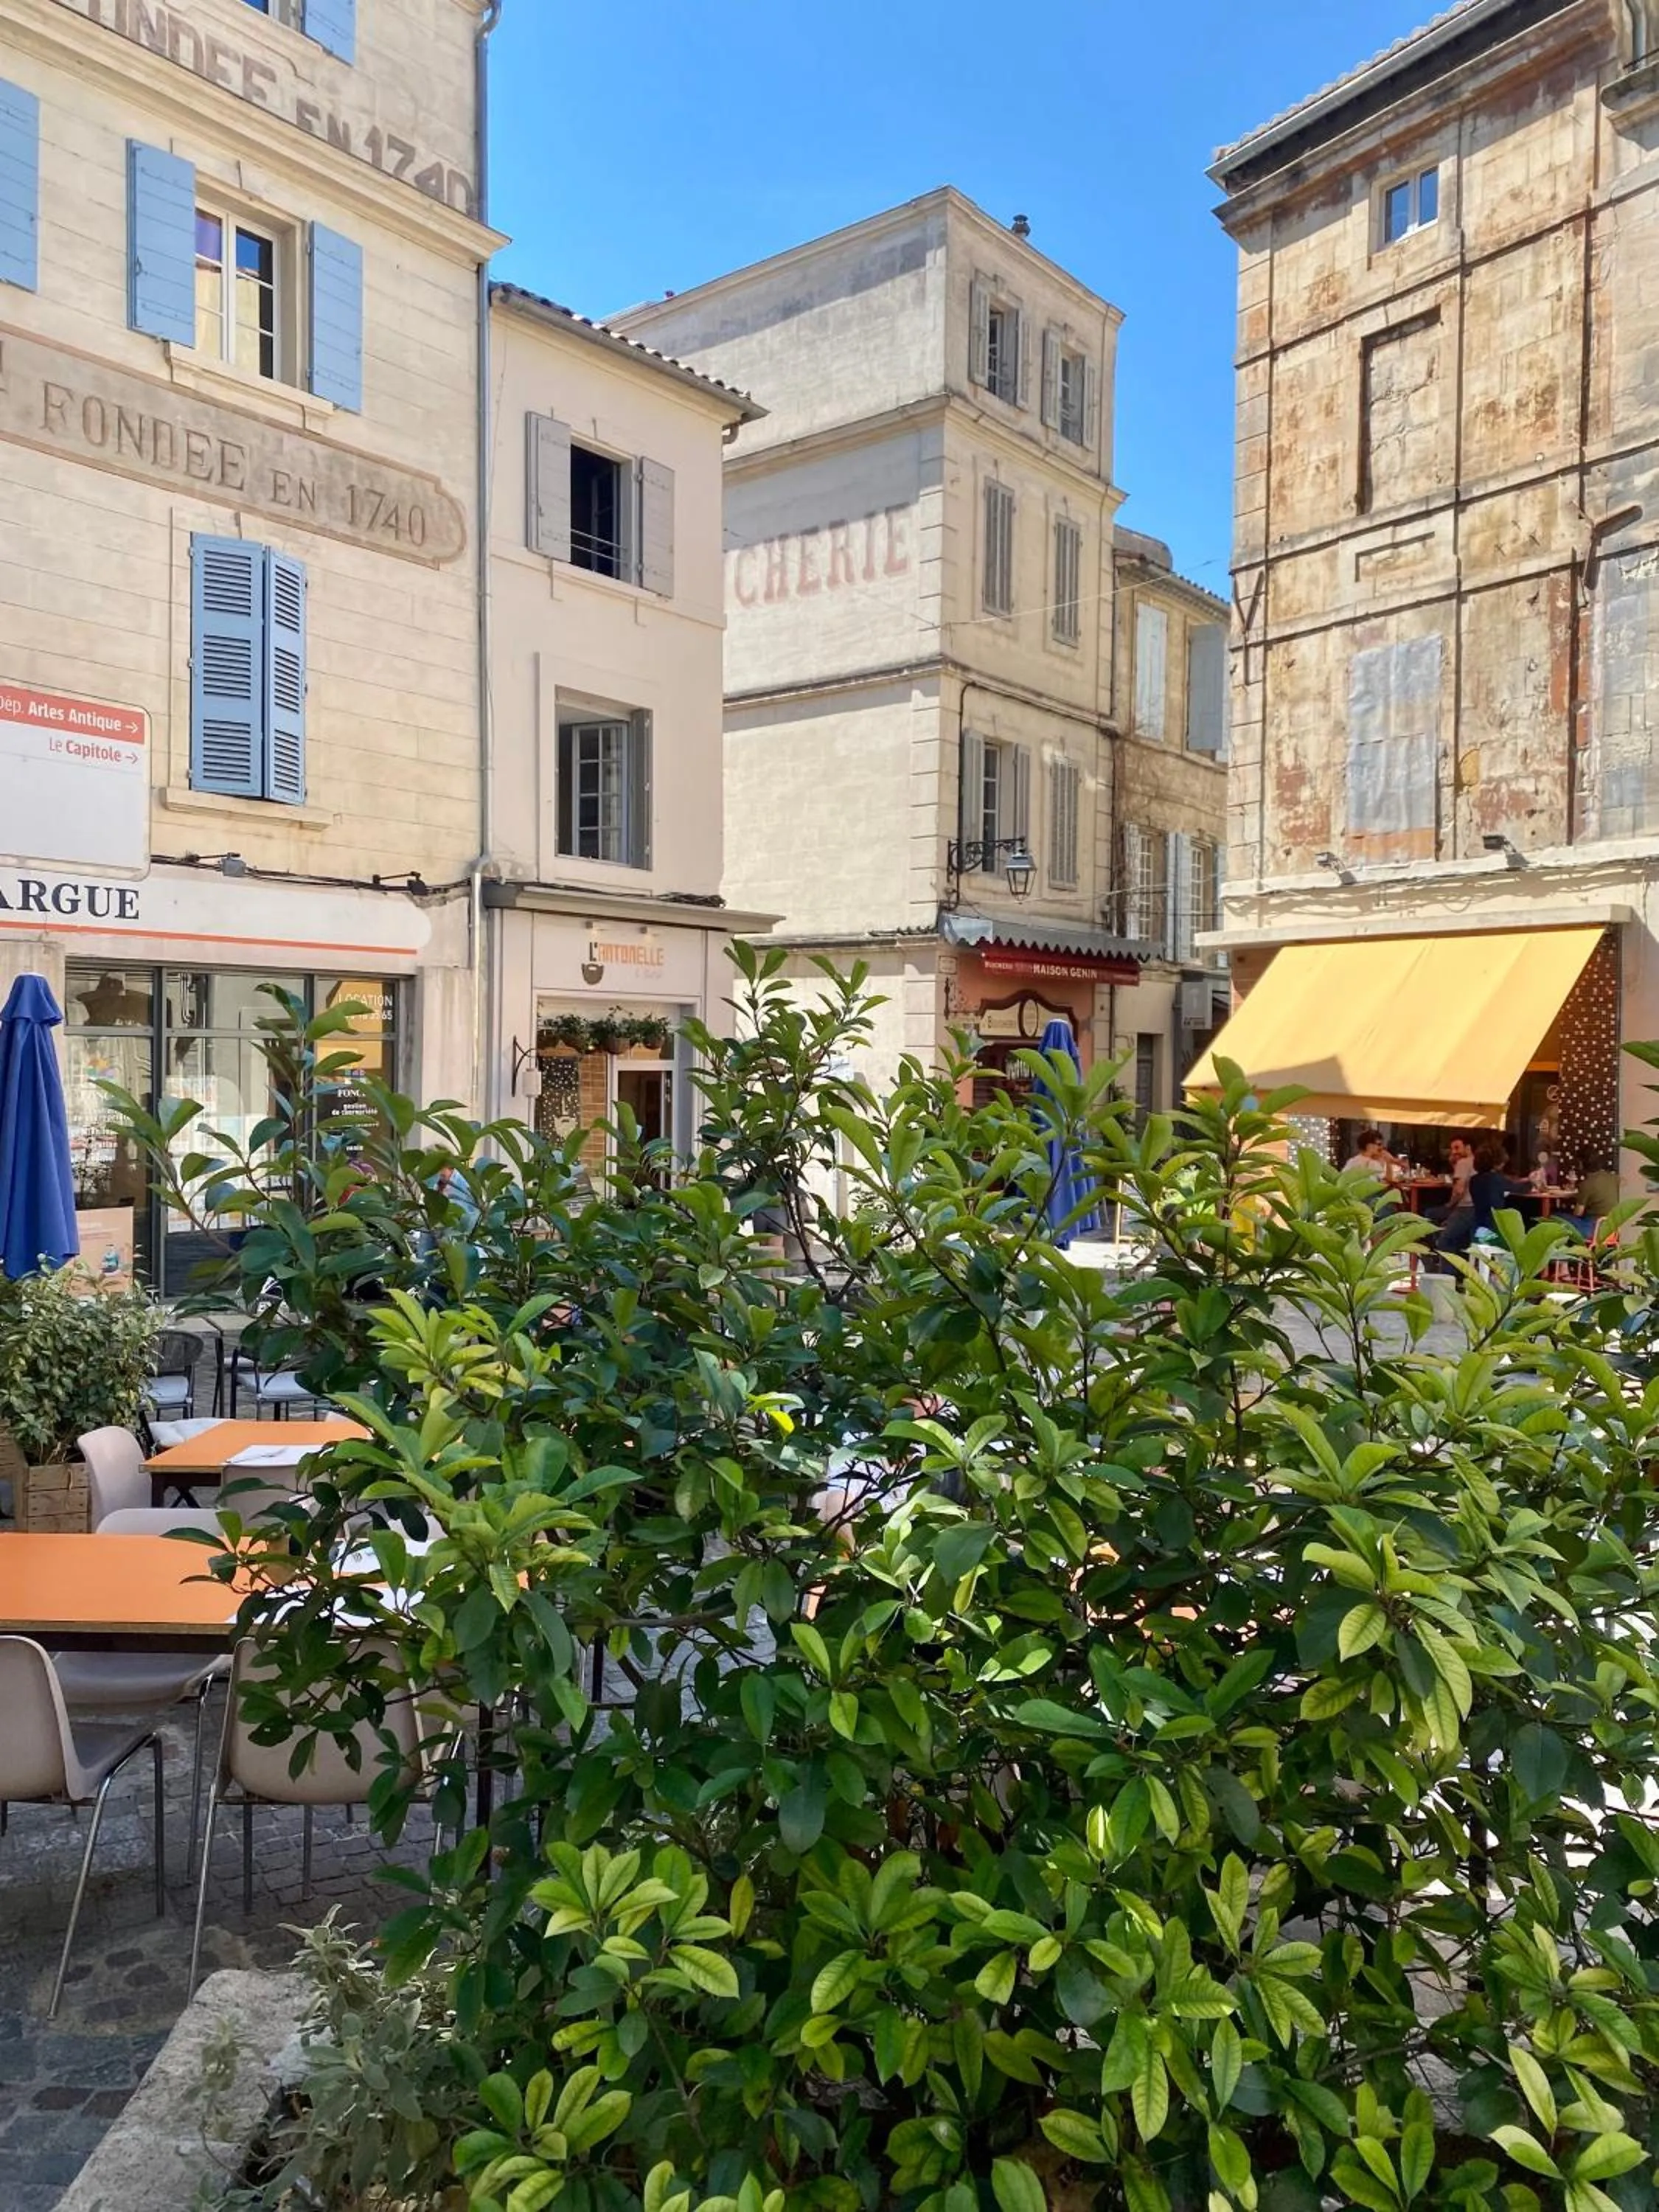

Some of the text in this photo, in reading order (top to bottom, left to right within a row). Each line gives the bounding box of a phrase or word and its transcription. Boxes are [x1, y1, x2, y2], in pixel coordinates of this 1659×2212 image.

[365, 125, 479, 221] 1740
[39, 379, 427, 546] FONDEE EN 1740
[28, 701, 64, 721] Arles
[68, 709, 122, 731] Antique
[49, 737, 121, 762] Le Capitole
[1033, 963, 1068, 977] MAISON
[1070, 967, 1097, 978] GENIN
